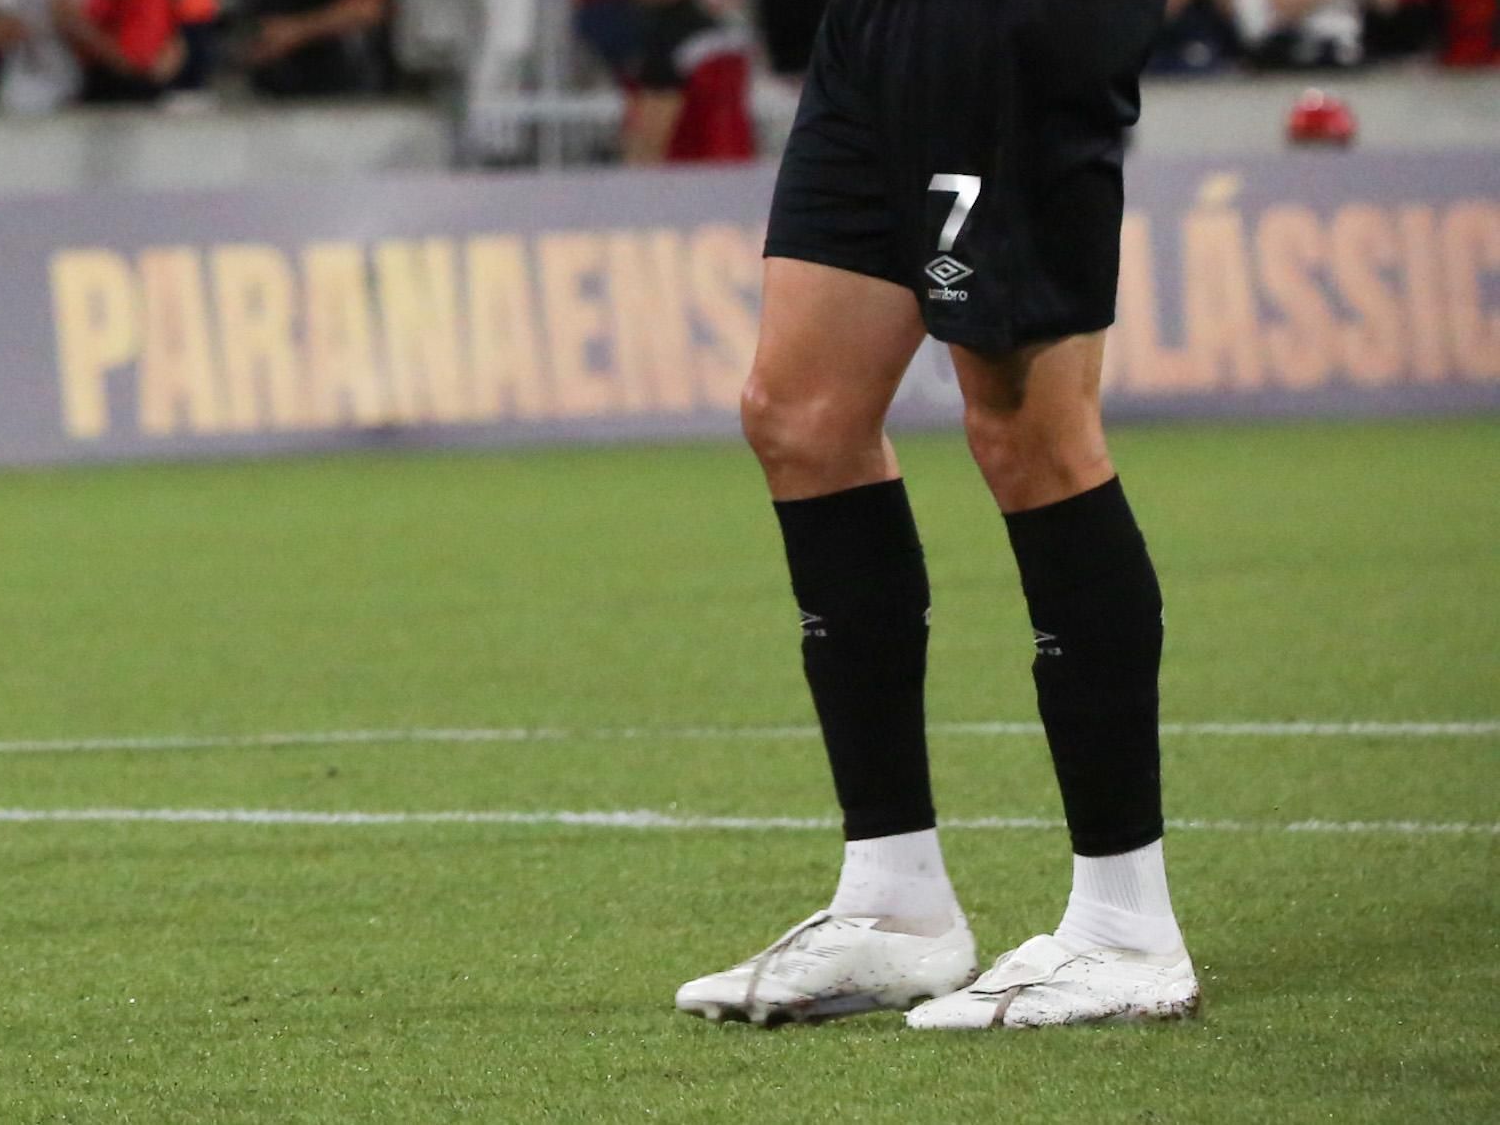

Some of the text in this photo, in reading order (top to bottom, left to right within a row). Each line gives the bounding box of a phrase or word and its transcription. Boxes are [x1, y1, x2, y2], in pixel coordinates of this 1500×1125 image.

[928, 173, 981, 252] 7
[50, 172, 1500, 438] PARANAENS LÁSSIC
[928, 286, 968, 302] umbro
